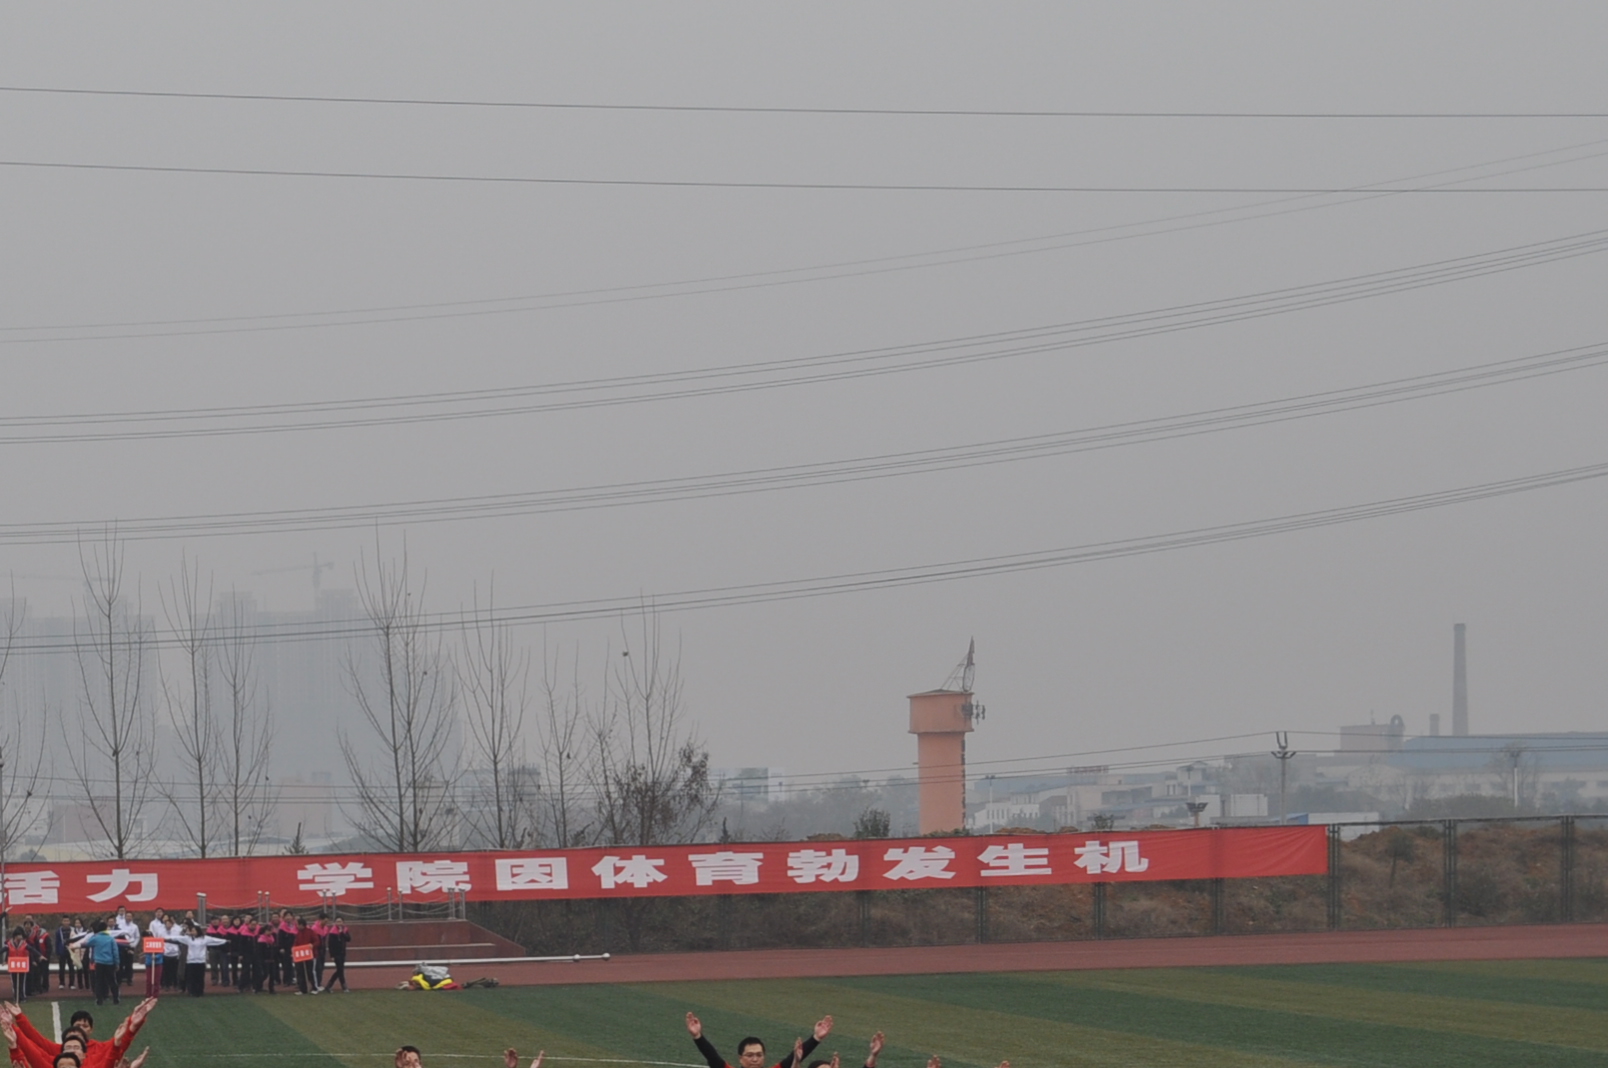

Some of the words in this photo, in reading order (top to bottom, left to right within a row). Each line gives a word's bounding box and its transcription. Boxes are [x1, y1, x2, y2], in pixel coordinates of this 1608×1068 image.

[297, 840, 1149, 896] 学院因体育勃发生机
